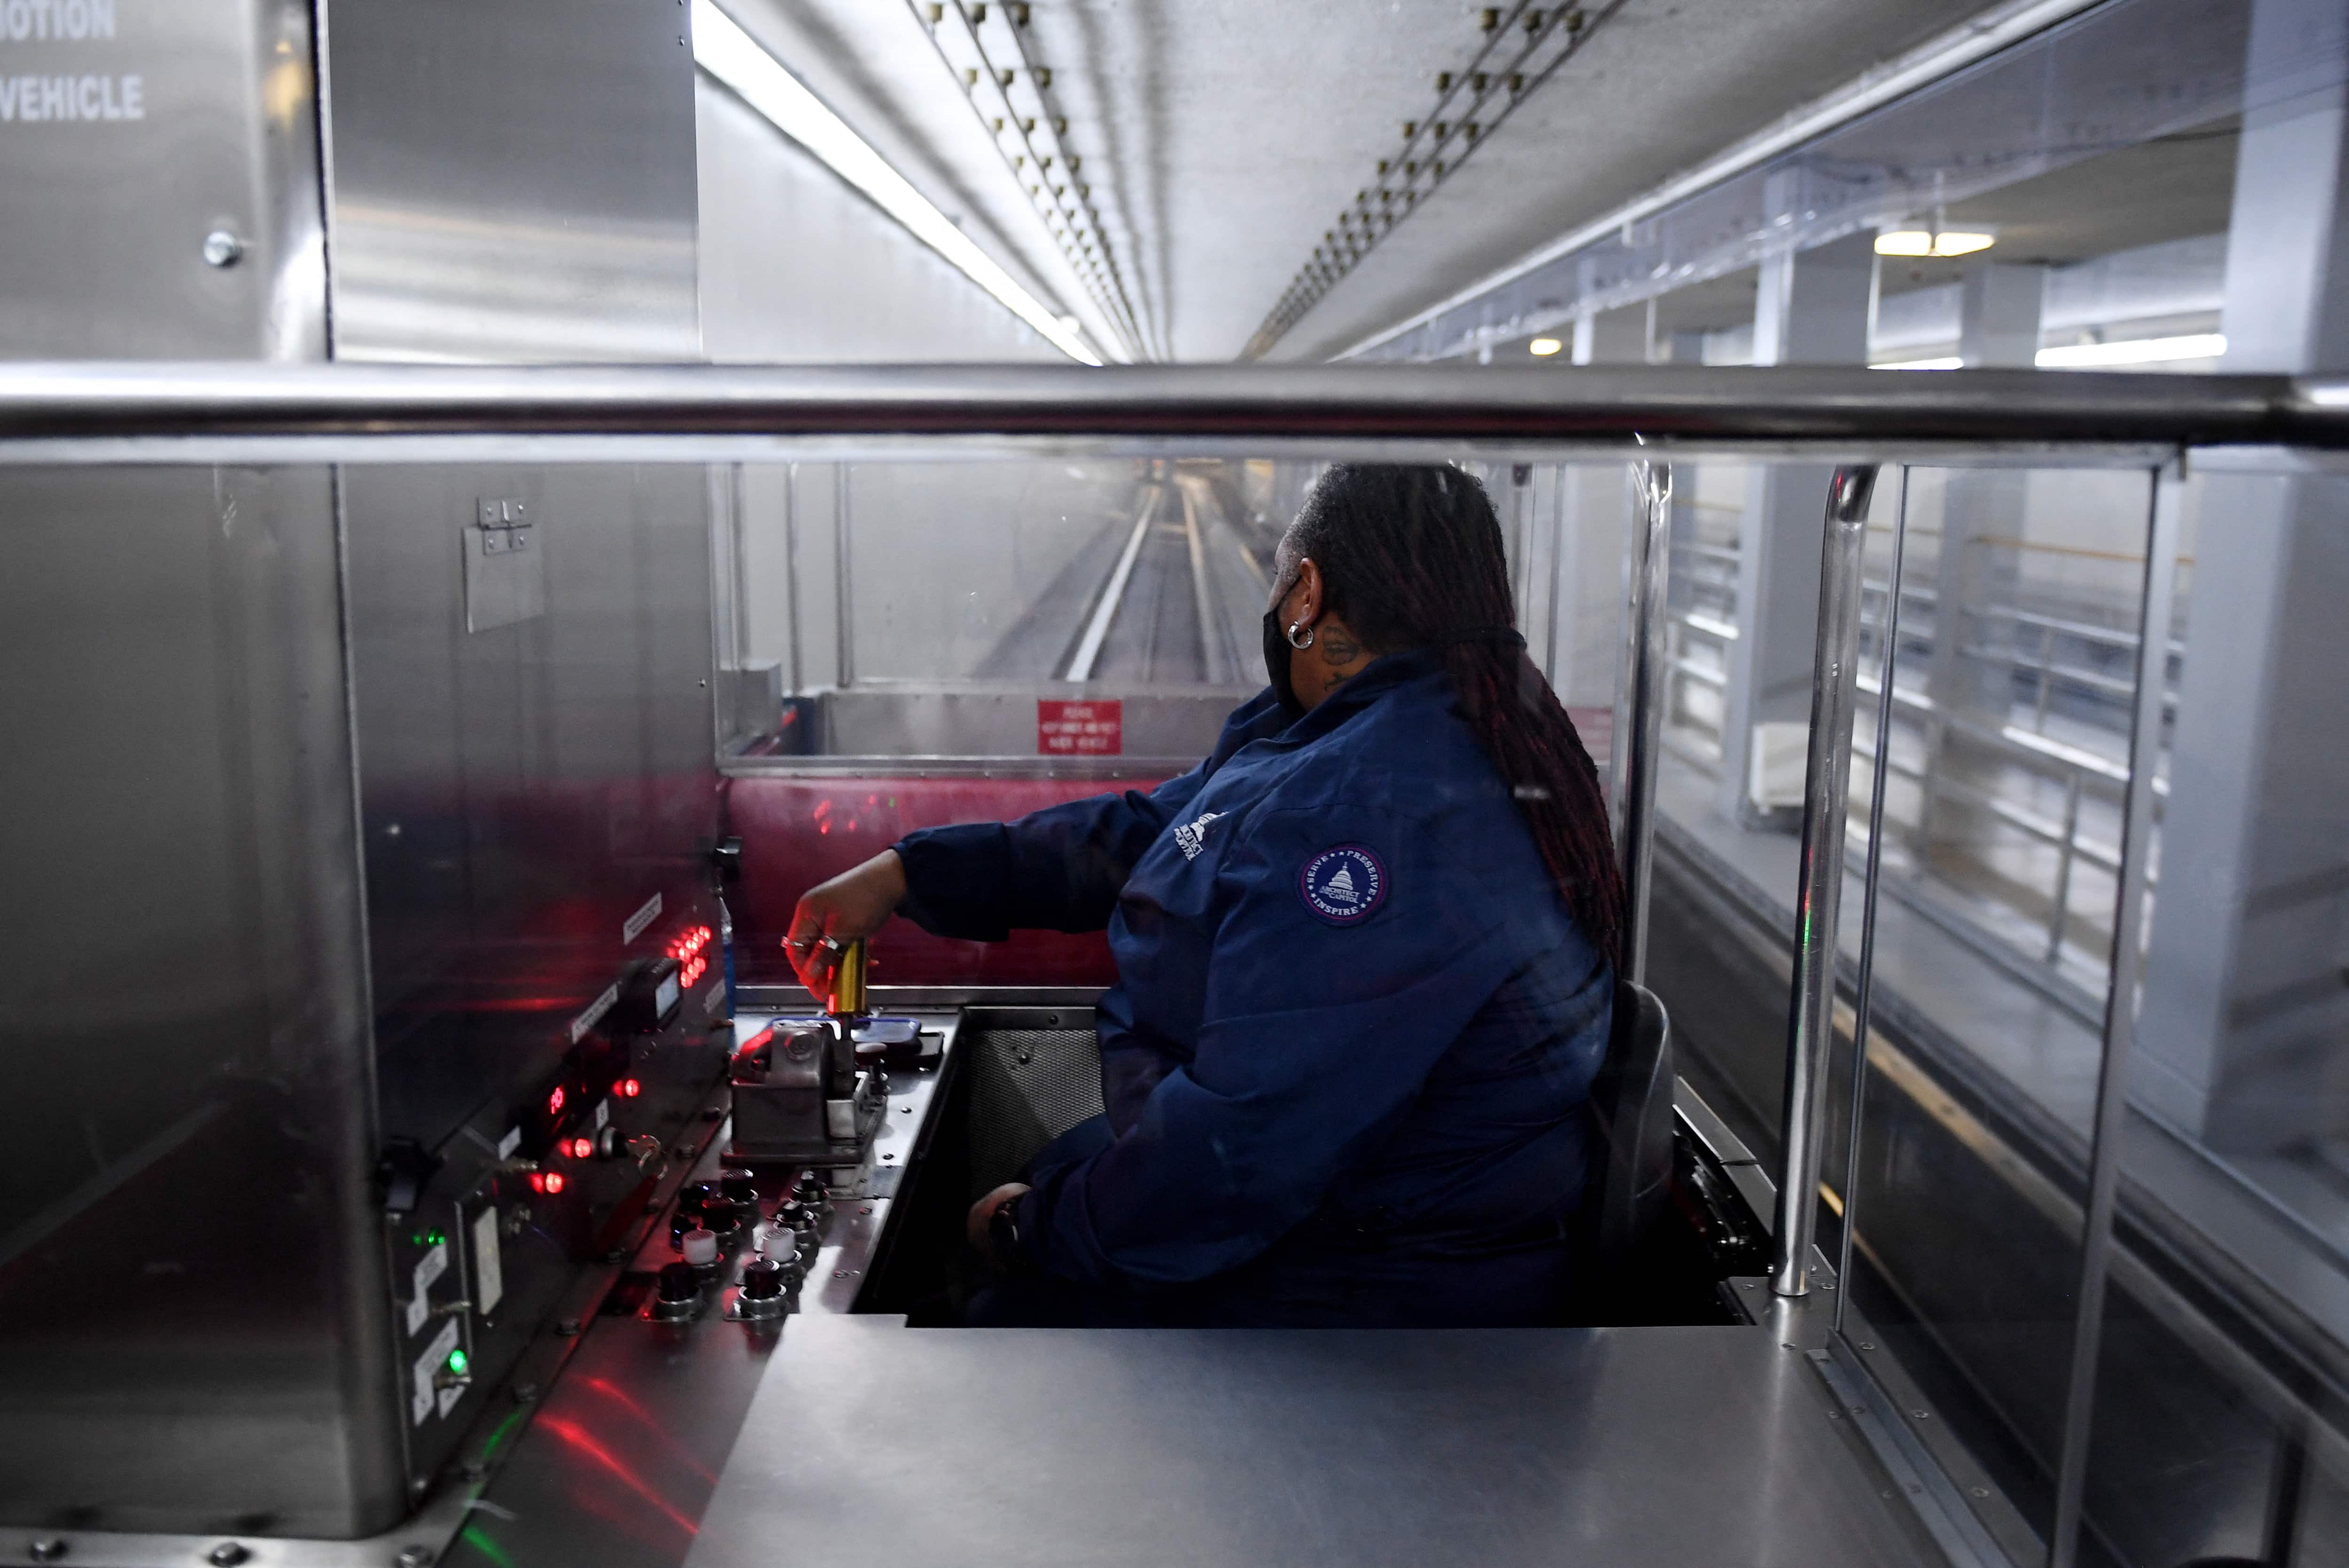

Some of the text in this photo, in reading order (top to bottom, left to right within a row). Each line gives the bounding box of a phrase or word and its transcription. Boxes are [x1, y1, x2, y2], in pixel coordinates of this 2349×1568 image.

[0, 0, 116, 39] OTION
[0, 75, 145, 121] VEHICLE
[1307, 855, 1329, 883] SERVE
[1347, 850, 1379, 896] PRESERVE
[1314, 898, 1359, 916] INSPIRE
